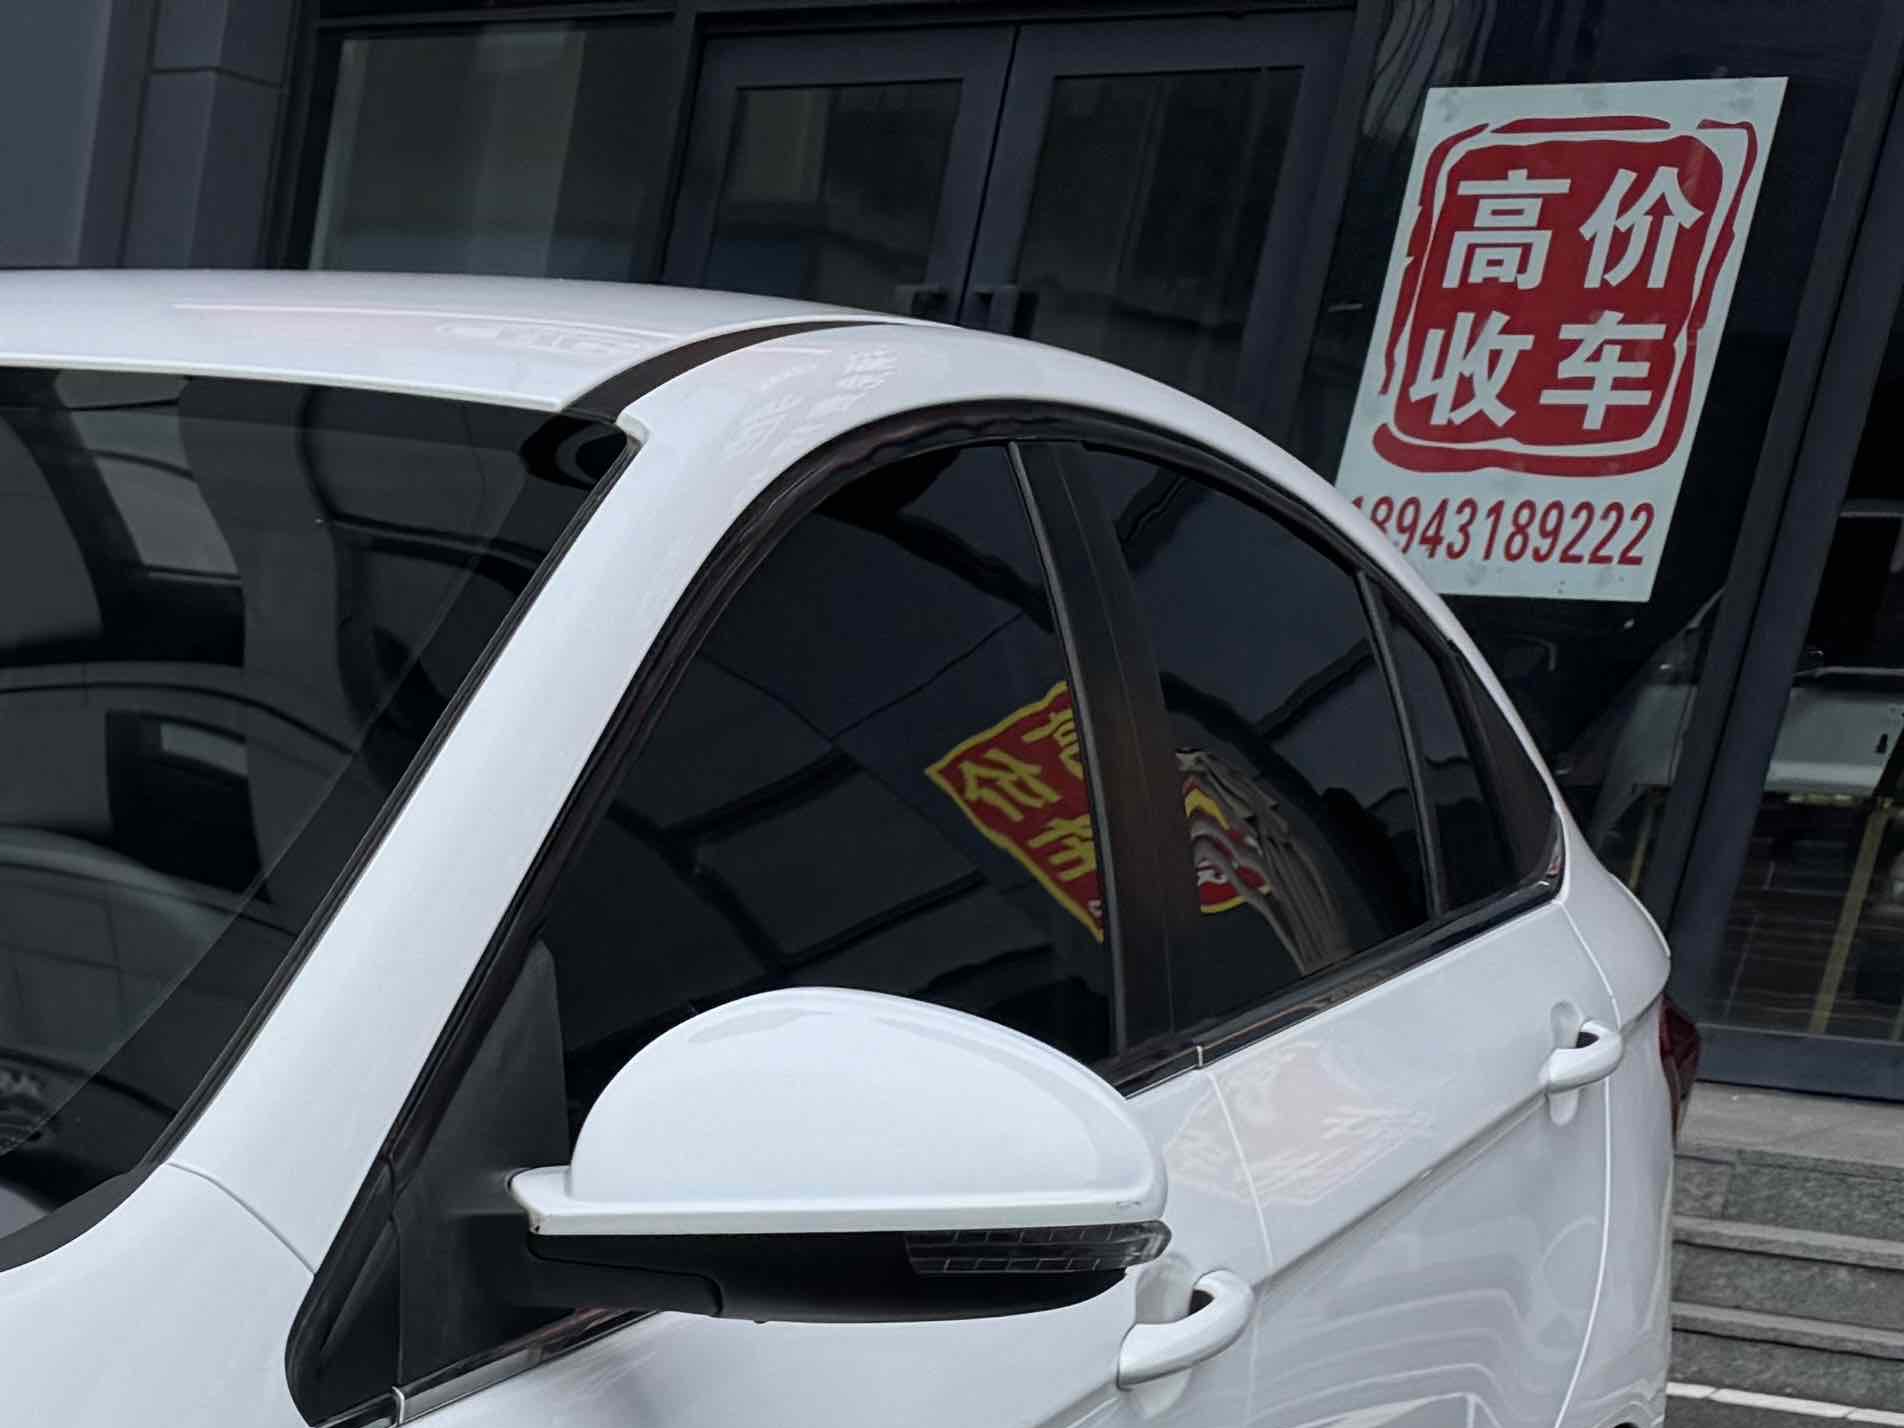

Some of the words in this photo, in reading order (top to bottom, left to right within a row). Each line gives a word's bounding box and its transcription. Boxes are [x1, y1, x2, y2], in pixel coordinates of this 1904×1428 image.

[1441, 166, 1704, 291] 高价
[1408, 309, 1666, 432] 收车
[1351, 495, 1657, 566] 8943189222
